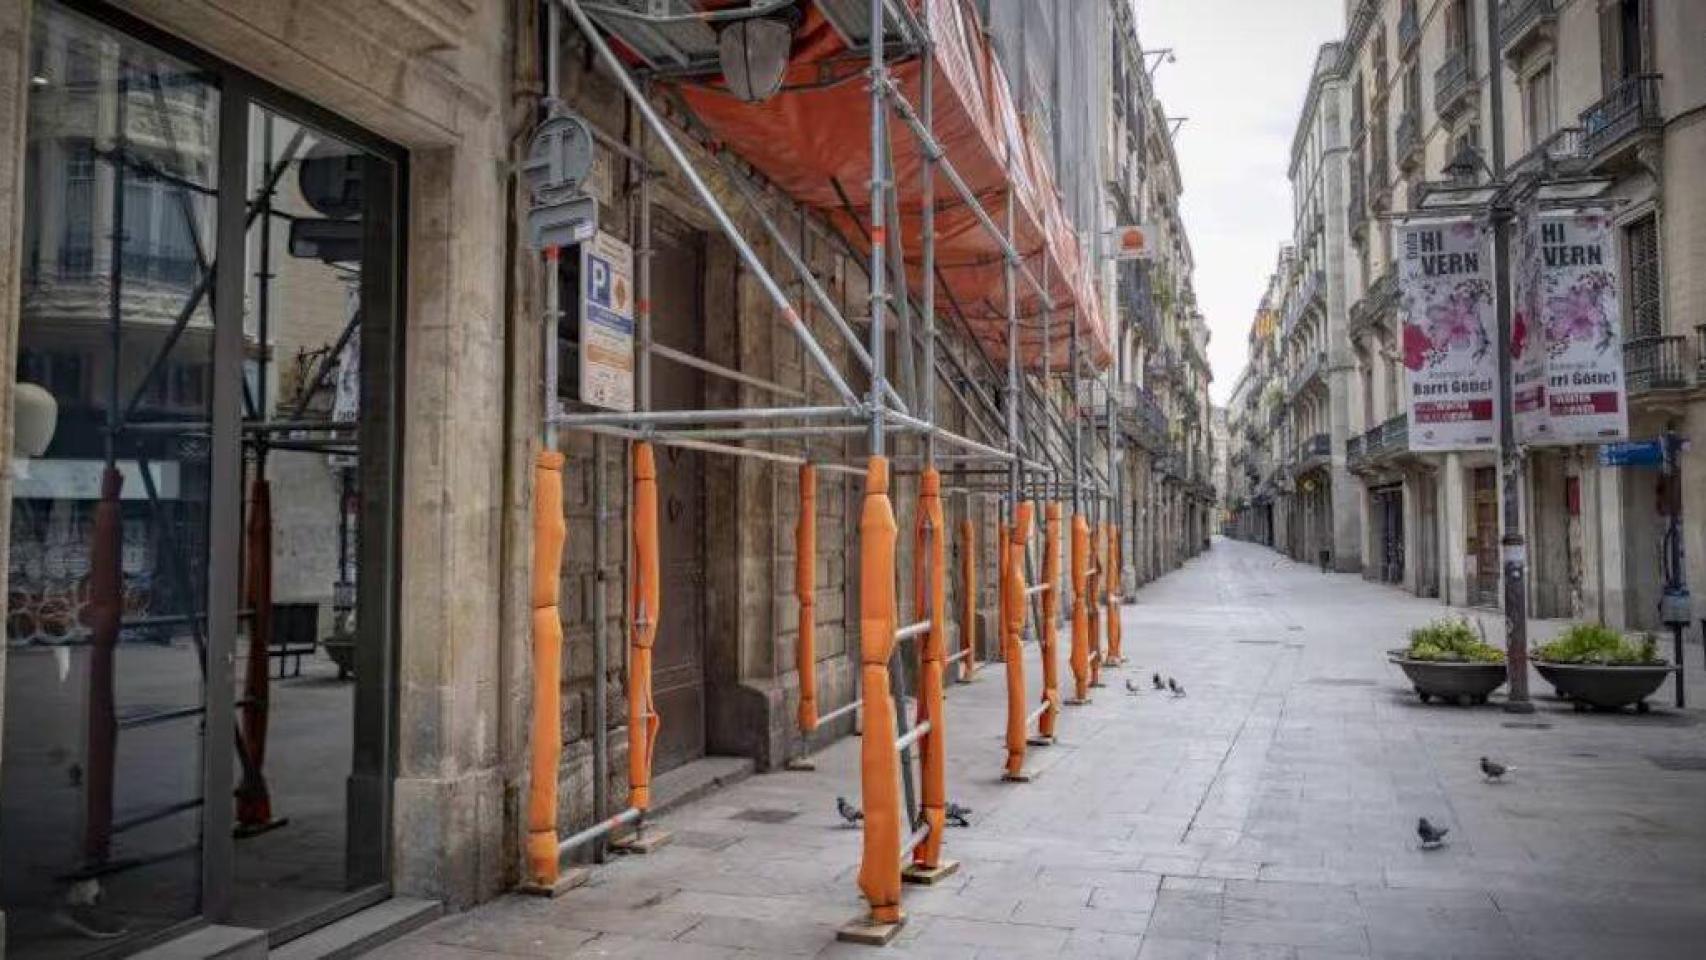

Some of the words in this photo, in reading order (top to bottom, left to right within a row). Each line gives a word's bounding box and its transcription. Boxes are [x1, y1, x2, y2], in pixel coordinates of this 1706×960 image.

[1421, 231, 1442, 251] HI
[1542, 224, 1564, 243] HI
[1422, 253, 1478, 275] VERN
[1542, 244, 1602, 266] VERN
[592, 258, 606, 300] P
